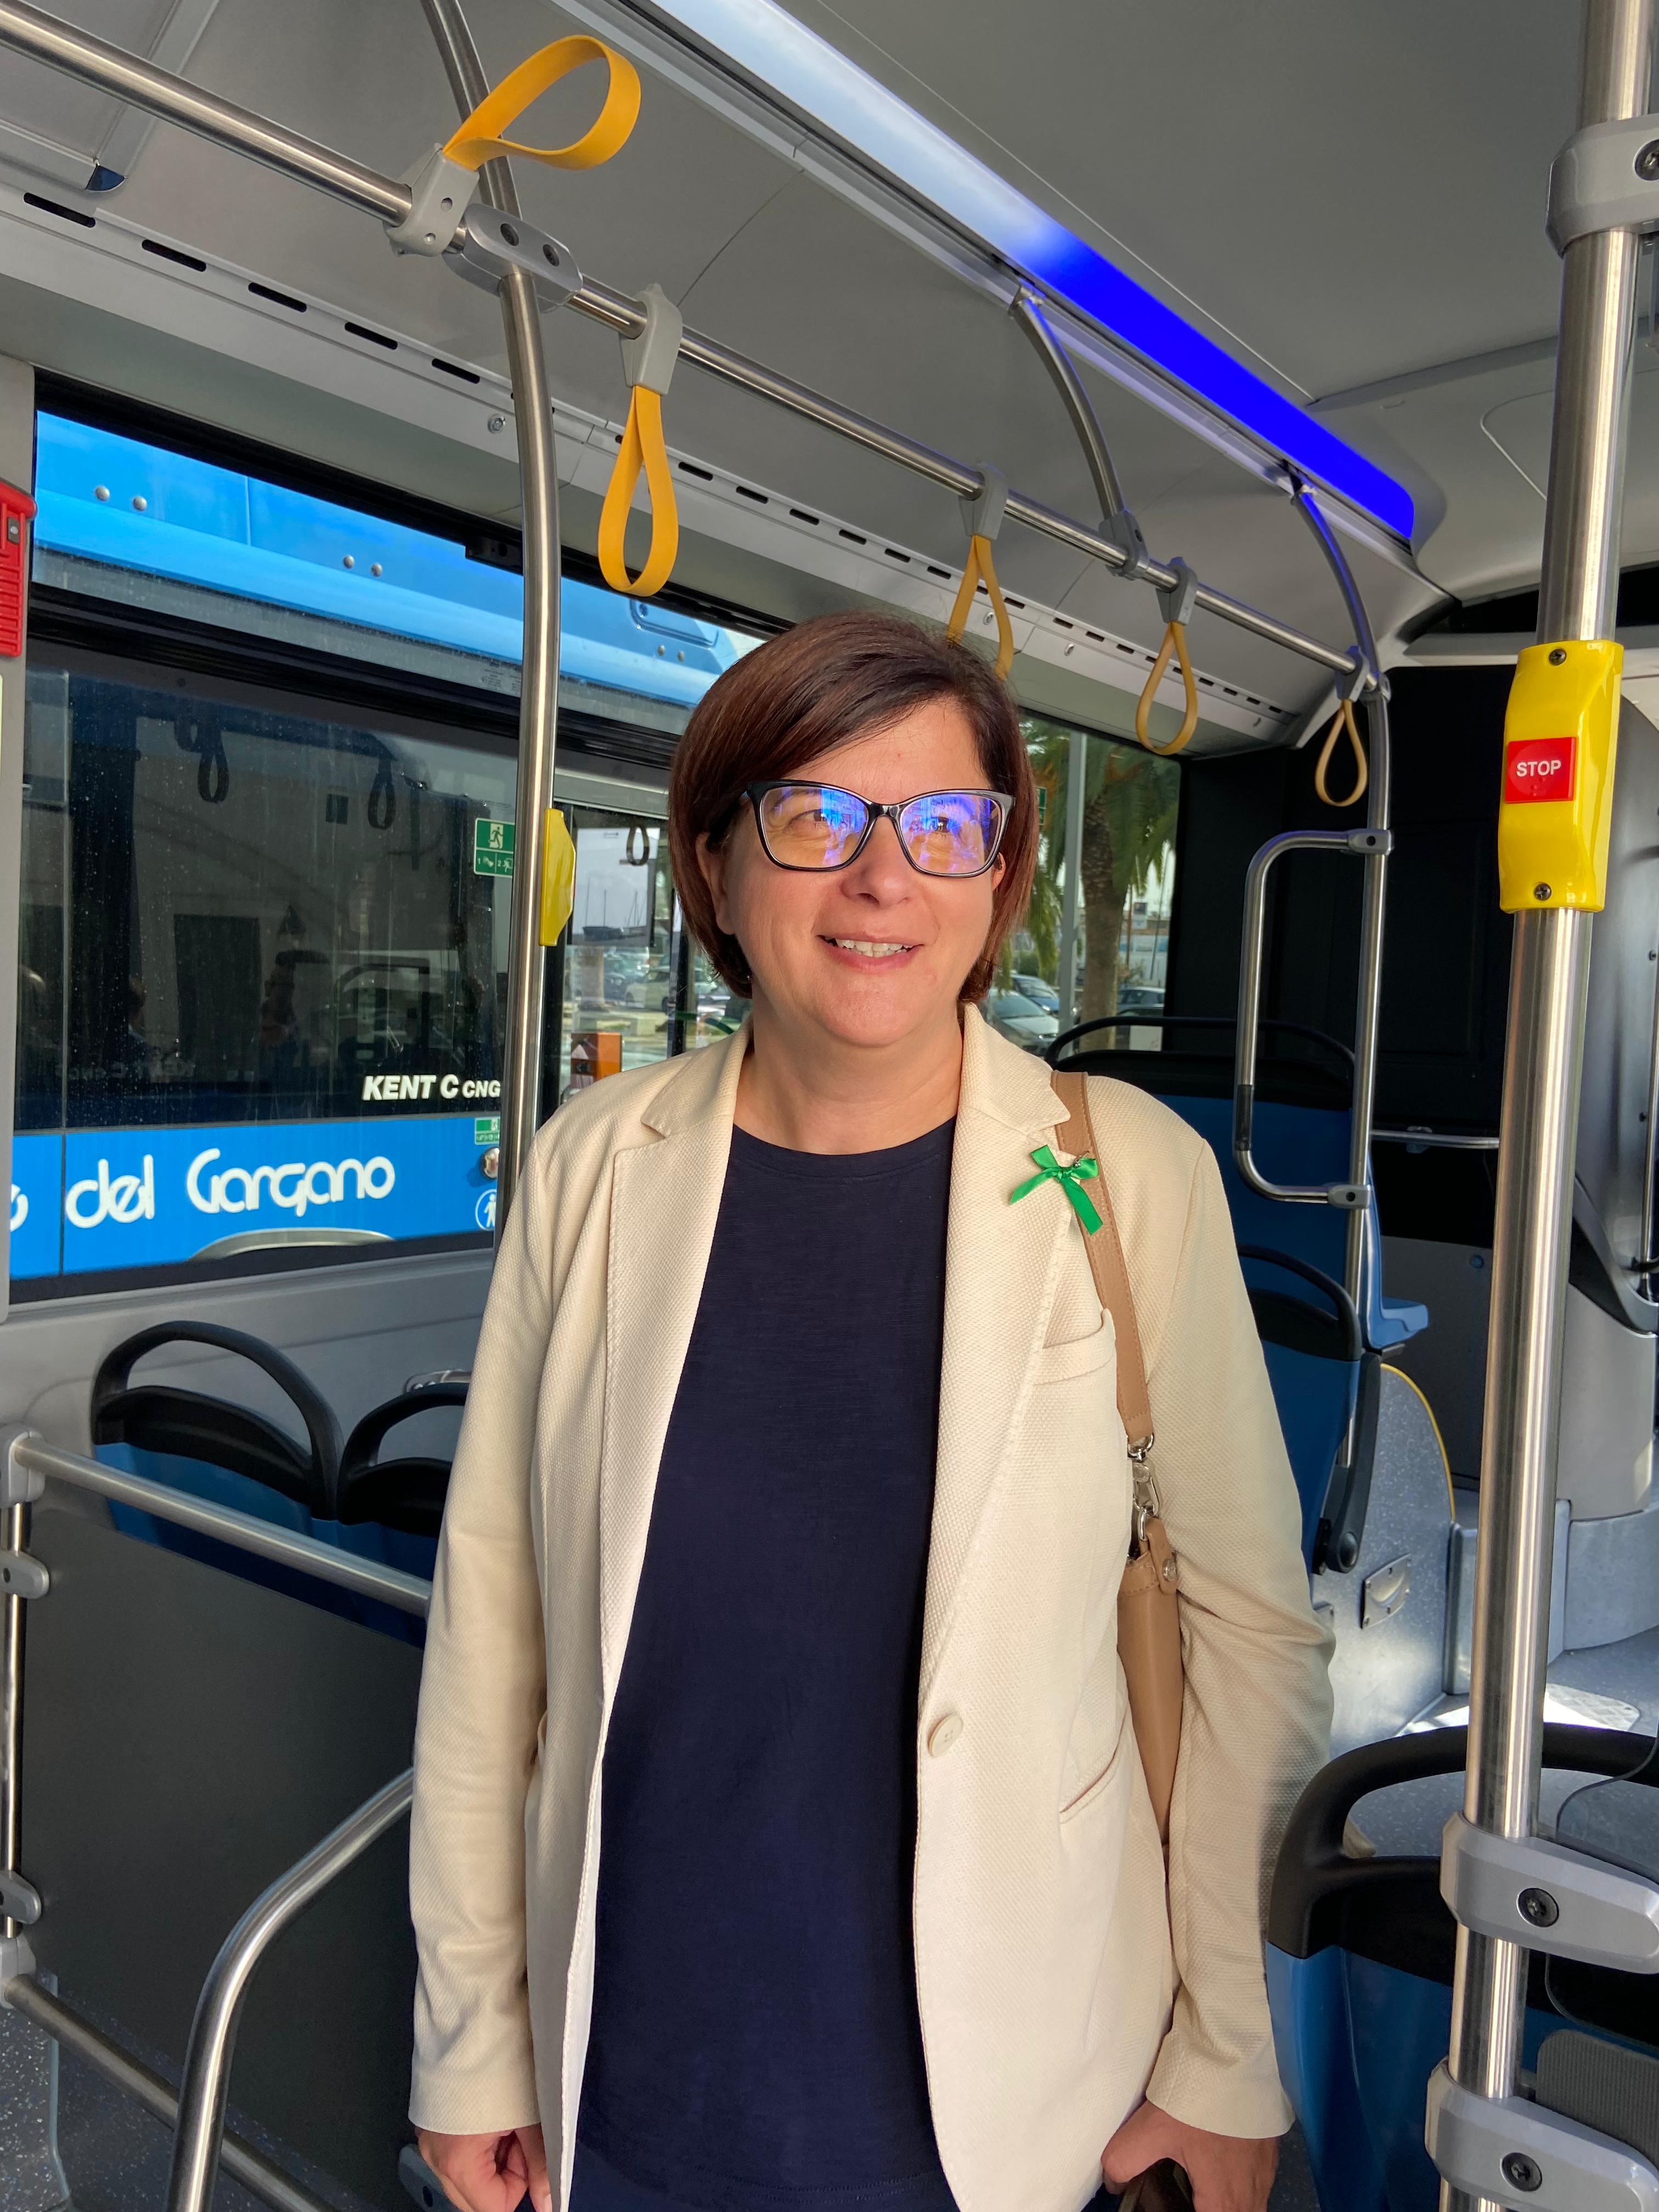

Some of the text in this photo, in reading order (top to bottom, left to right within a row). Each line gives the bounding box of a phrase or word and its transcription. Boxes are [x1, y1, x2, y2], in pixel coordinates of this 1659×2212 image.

[1516, 759, 1562, 777] STOP
[362, 1074, 500, 1101] KENT C CNG
[65, 1154, 155, 1229] del
[185, 1148, 396, 1217] Gargano
